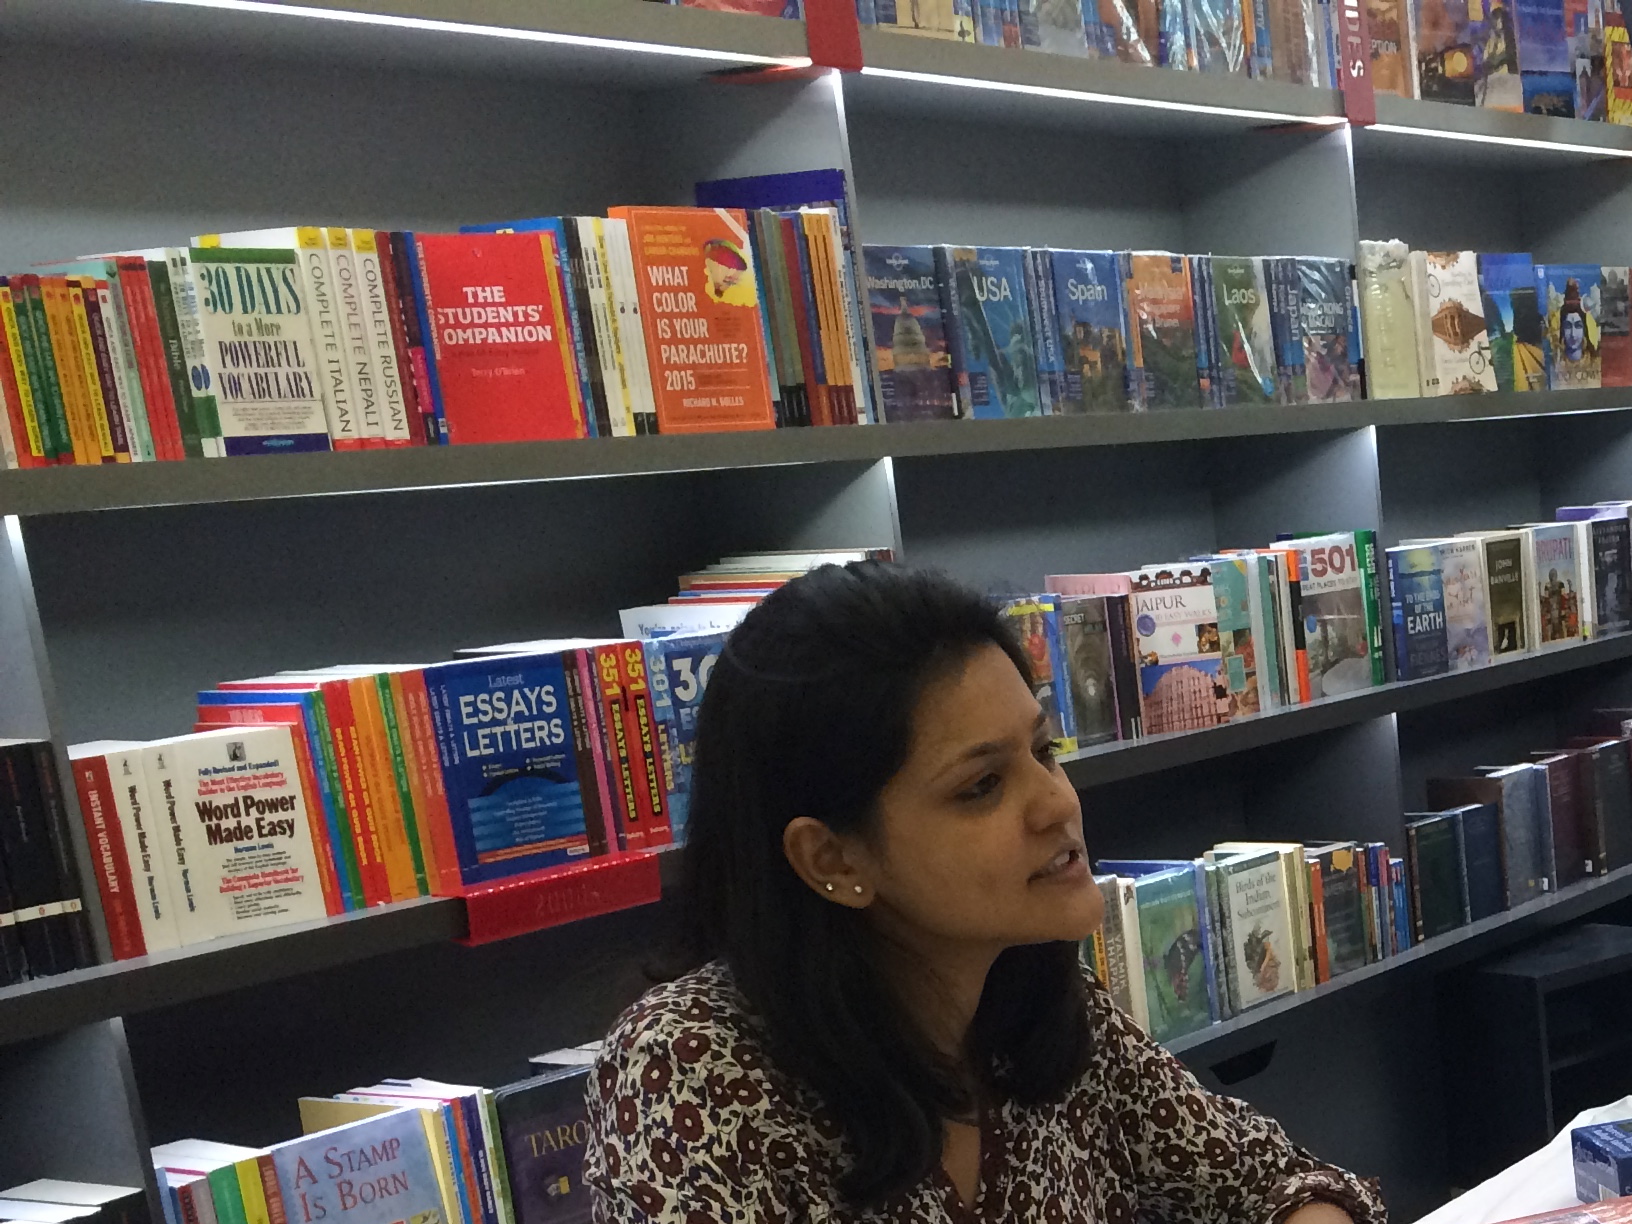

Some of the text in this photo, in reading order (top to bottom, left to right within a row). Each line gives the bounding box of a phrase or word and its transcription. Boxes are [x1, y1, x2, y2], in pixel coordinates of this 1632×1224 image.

[200, 264, 302, 316] 30 DAYS
[647, 266, 688, 287] WHAT
[974, 275, 1013, 302] USA
[463, 286, 506, 303] THE
[652, 292, 697, 313] COLOR
[1223, 285, 1256, 306] Laos
[232, 319, 244, 337] to
[254, 317, 282, 337] More
[305, 251, 355, 434] COMPLETE ITALIAN
[331, 252, 381, 428] COMPLETE NEPALI
[441, 325, 552, 345] OMPANION
[657, 318, 709, 339] IS YOUR
[218, 340, 305, 369] POWERFUL
[359, 256, 407, 432] COMPLETE RUSSIAN
[660, 343, 748, 365] PARACHUTE?
[218, 371, 315, 400] VOCABULARY
[664, 370, 696, 391] 2015
[1310, 543, 1357, 578] 501
[1135, 594, 1187, 615] JAIPUR
[1407, 612, 1443, 634] EARTH
[488, 673, 524, 688] Latest
[600, 653, 621, 698] 351
[625, 648, 646, 691] 351
[651, 654, 672, 707] 301
[459, 684, 557, 725] ESSAYS
[463, 718, 565, 758] LETTERS
[195, 795, 296, 823] Word Power
[86, 789, 122, 893] INSTANT VOCABULARY
[132, 805, 145, 831] Power
[140, 853, 153, 872] Easy
[166, 799, 180, 824] Power
[174, 846, 188, 866] Easy
[205, 816, 295, 846] Made Easy
[1106, 932, 1121, 996] THAPAR
[526, 1119, 587, 1158] TARO
[294, 1137, 401, 1190] A STAMP
[301, 1191, 327, 1224] IS
[337, 1170, 409, 1212] BORN
